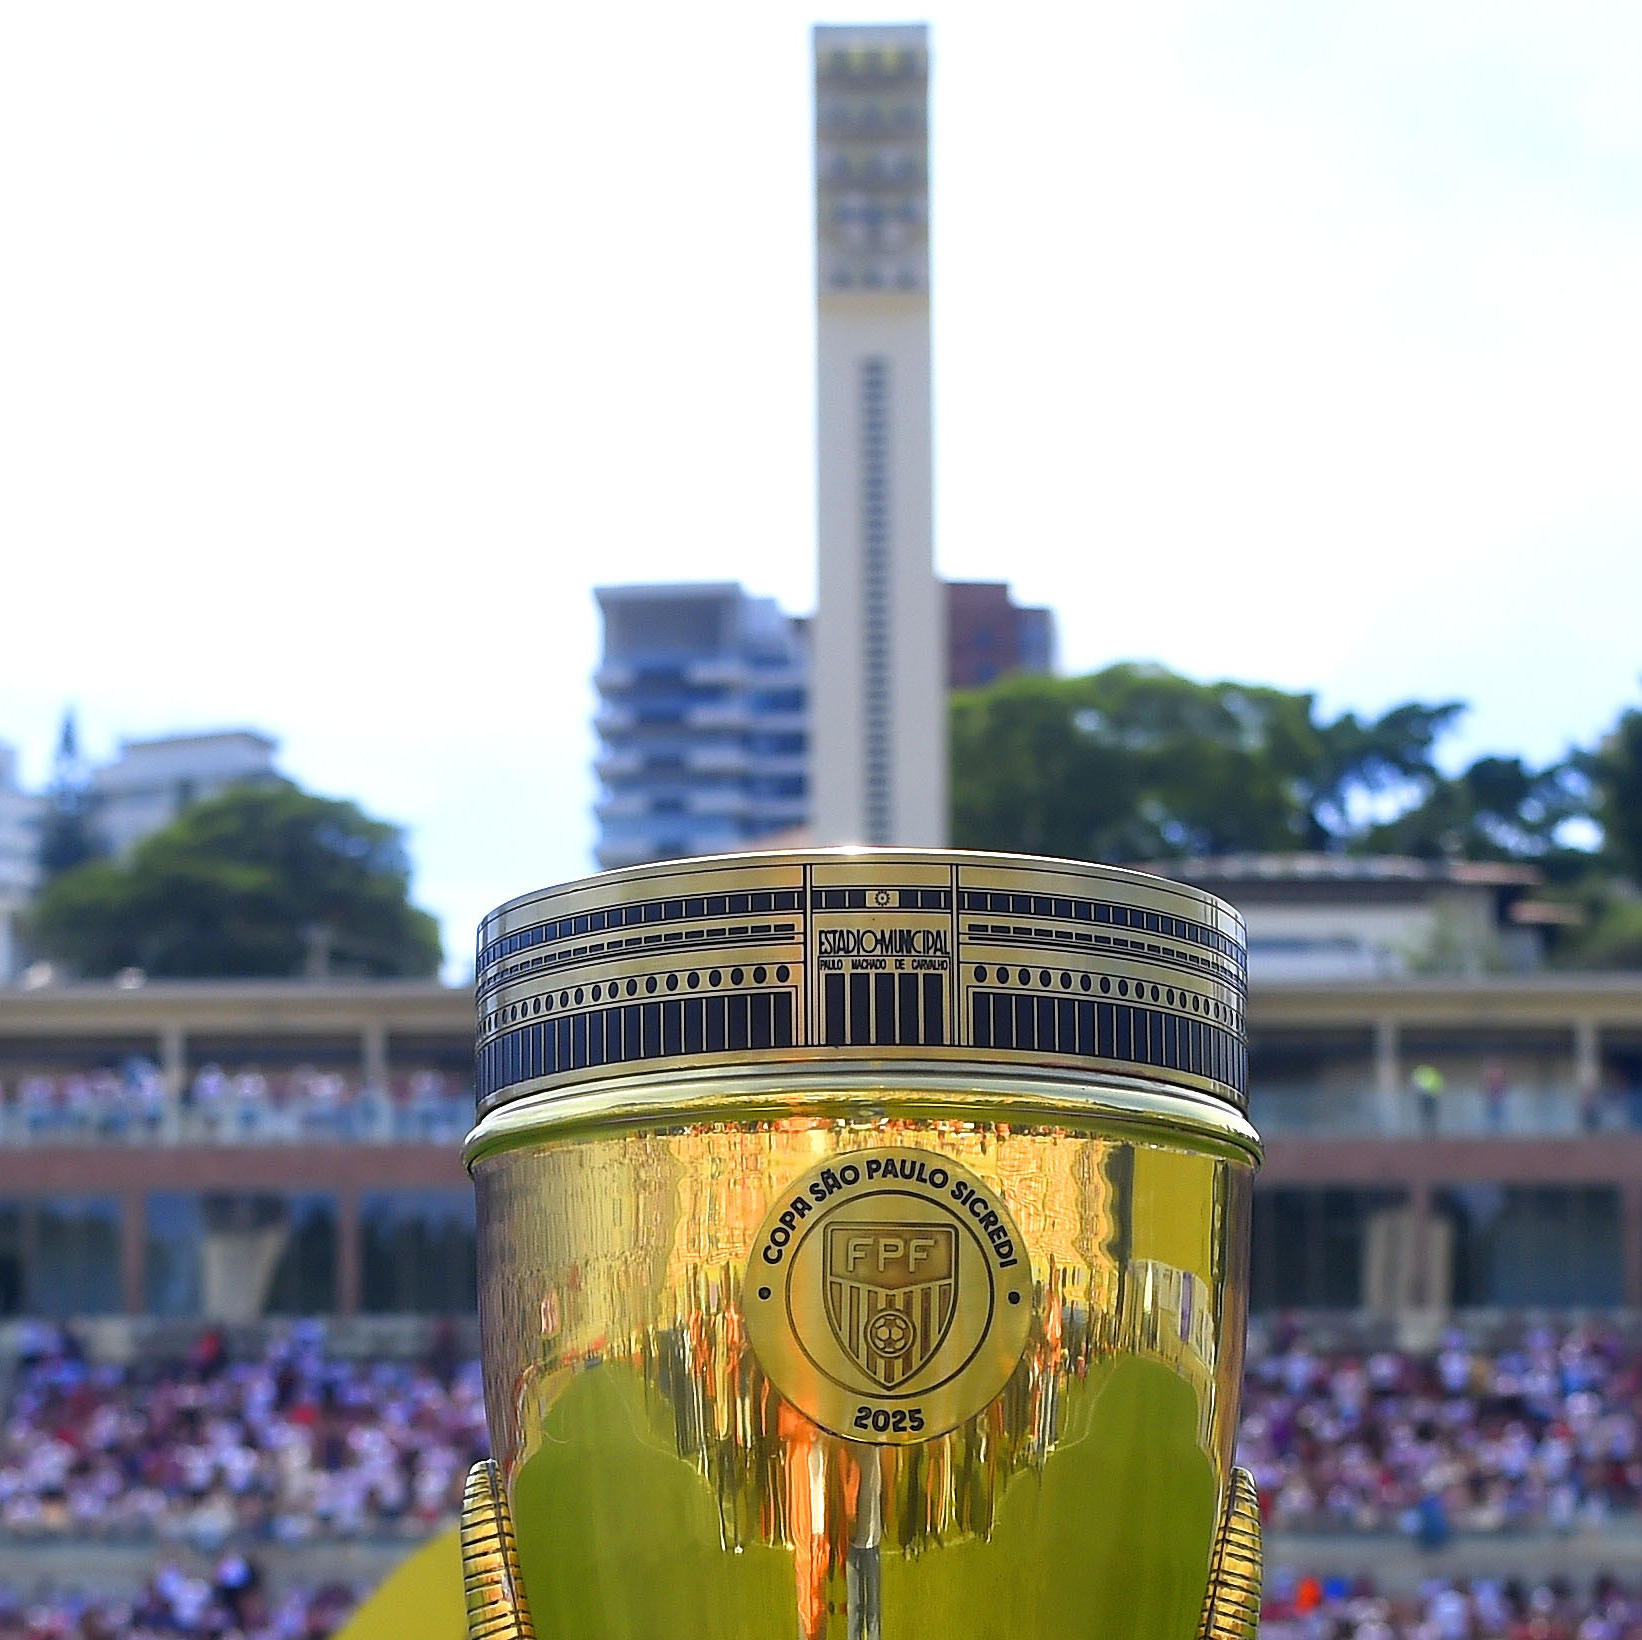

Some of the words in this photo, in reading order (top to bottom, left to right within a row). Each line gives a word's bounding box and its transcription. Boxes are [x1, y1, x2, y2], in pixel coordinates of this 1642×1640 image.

[820, 959, 843, 970] PAULO
[851, 959, 887, 970] MACHADO
[895, 959, 905, 970] DE
[911, 959, 949, 970] CARVALHO
[762, 1196, 813, 1265] COPA
[809, 1165, 861, 1202] SÃO
[865, 1158, 950, 1189] PAULO
[950, 1180, 1018, 1269] SICREDI
[846, 1236, 936, 1273] FPF
[853, 1406, 925, 1433] 2025
